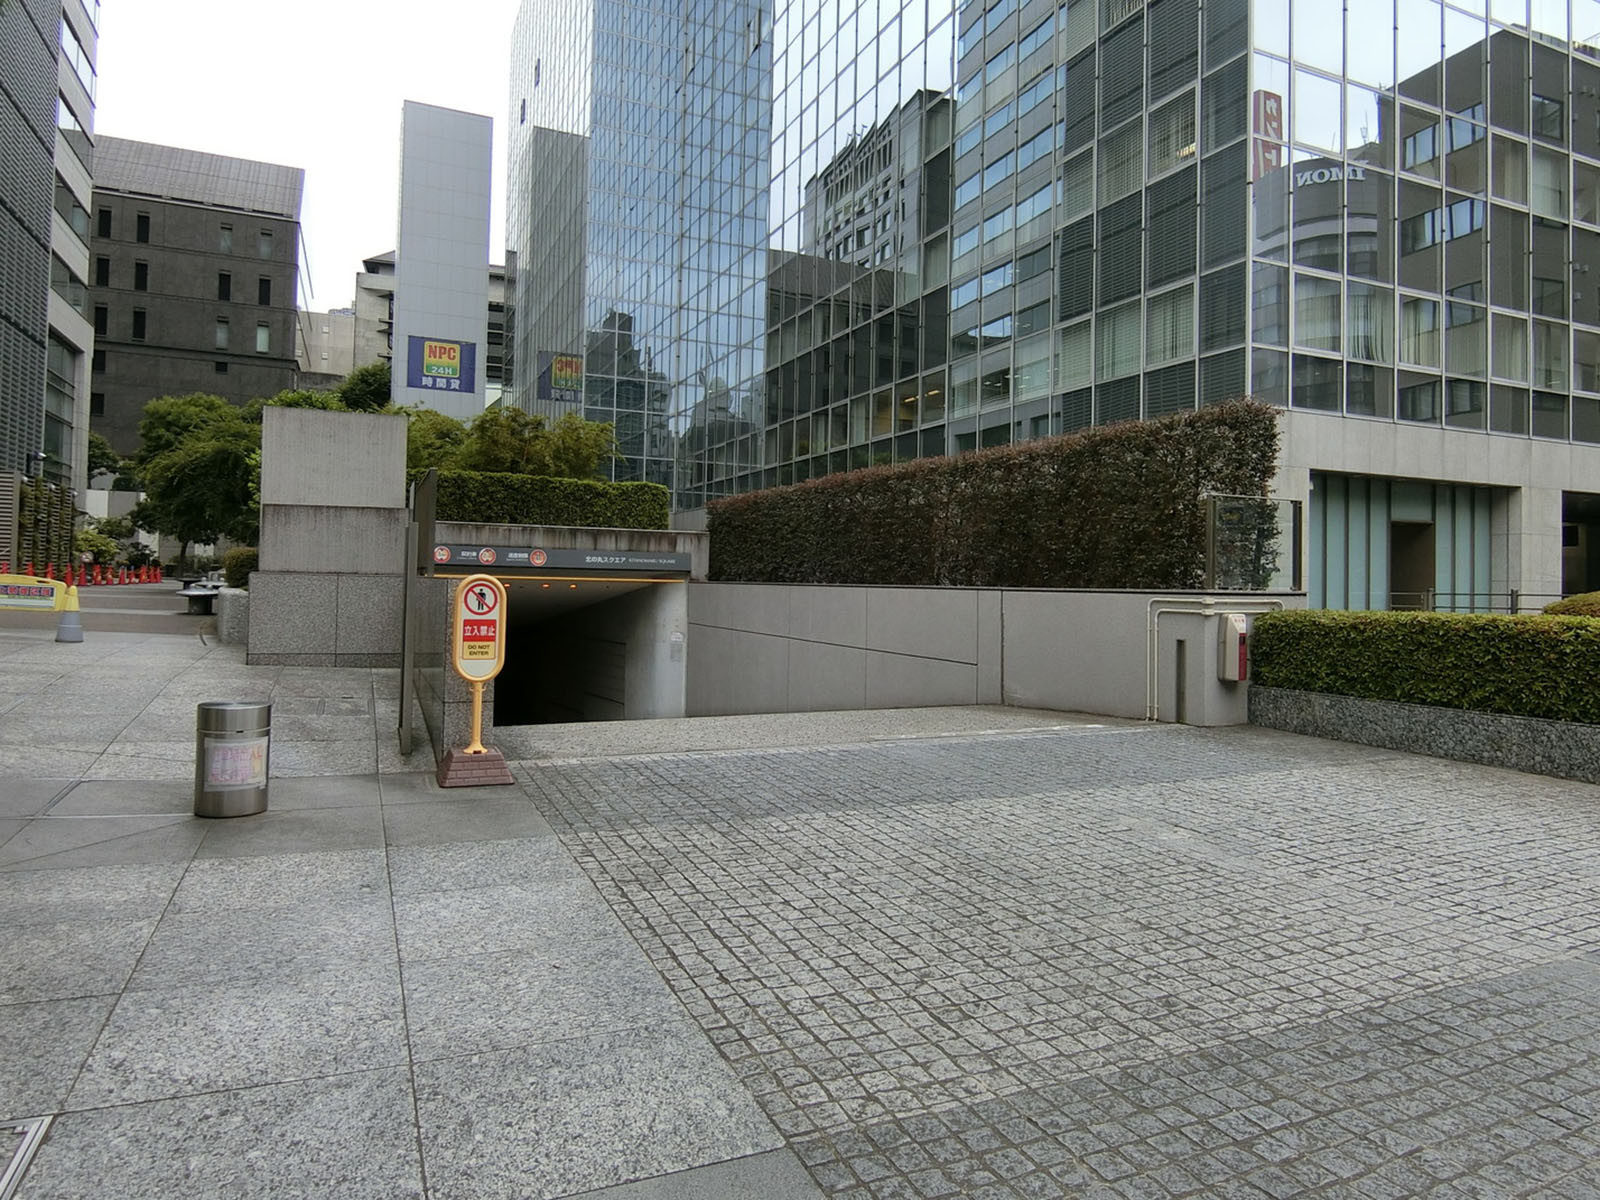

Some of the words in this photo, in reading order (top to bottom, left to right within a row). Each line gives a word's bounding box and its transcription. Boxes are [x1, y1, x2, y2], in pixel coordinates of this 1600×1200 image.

[428, 344, 457, 360] NPC
[431, 366, 453, 375] 24H
[422, 376, 460, 389] 時間貸
[464, 625, 496, 636] 立入禁止
